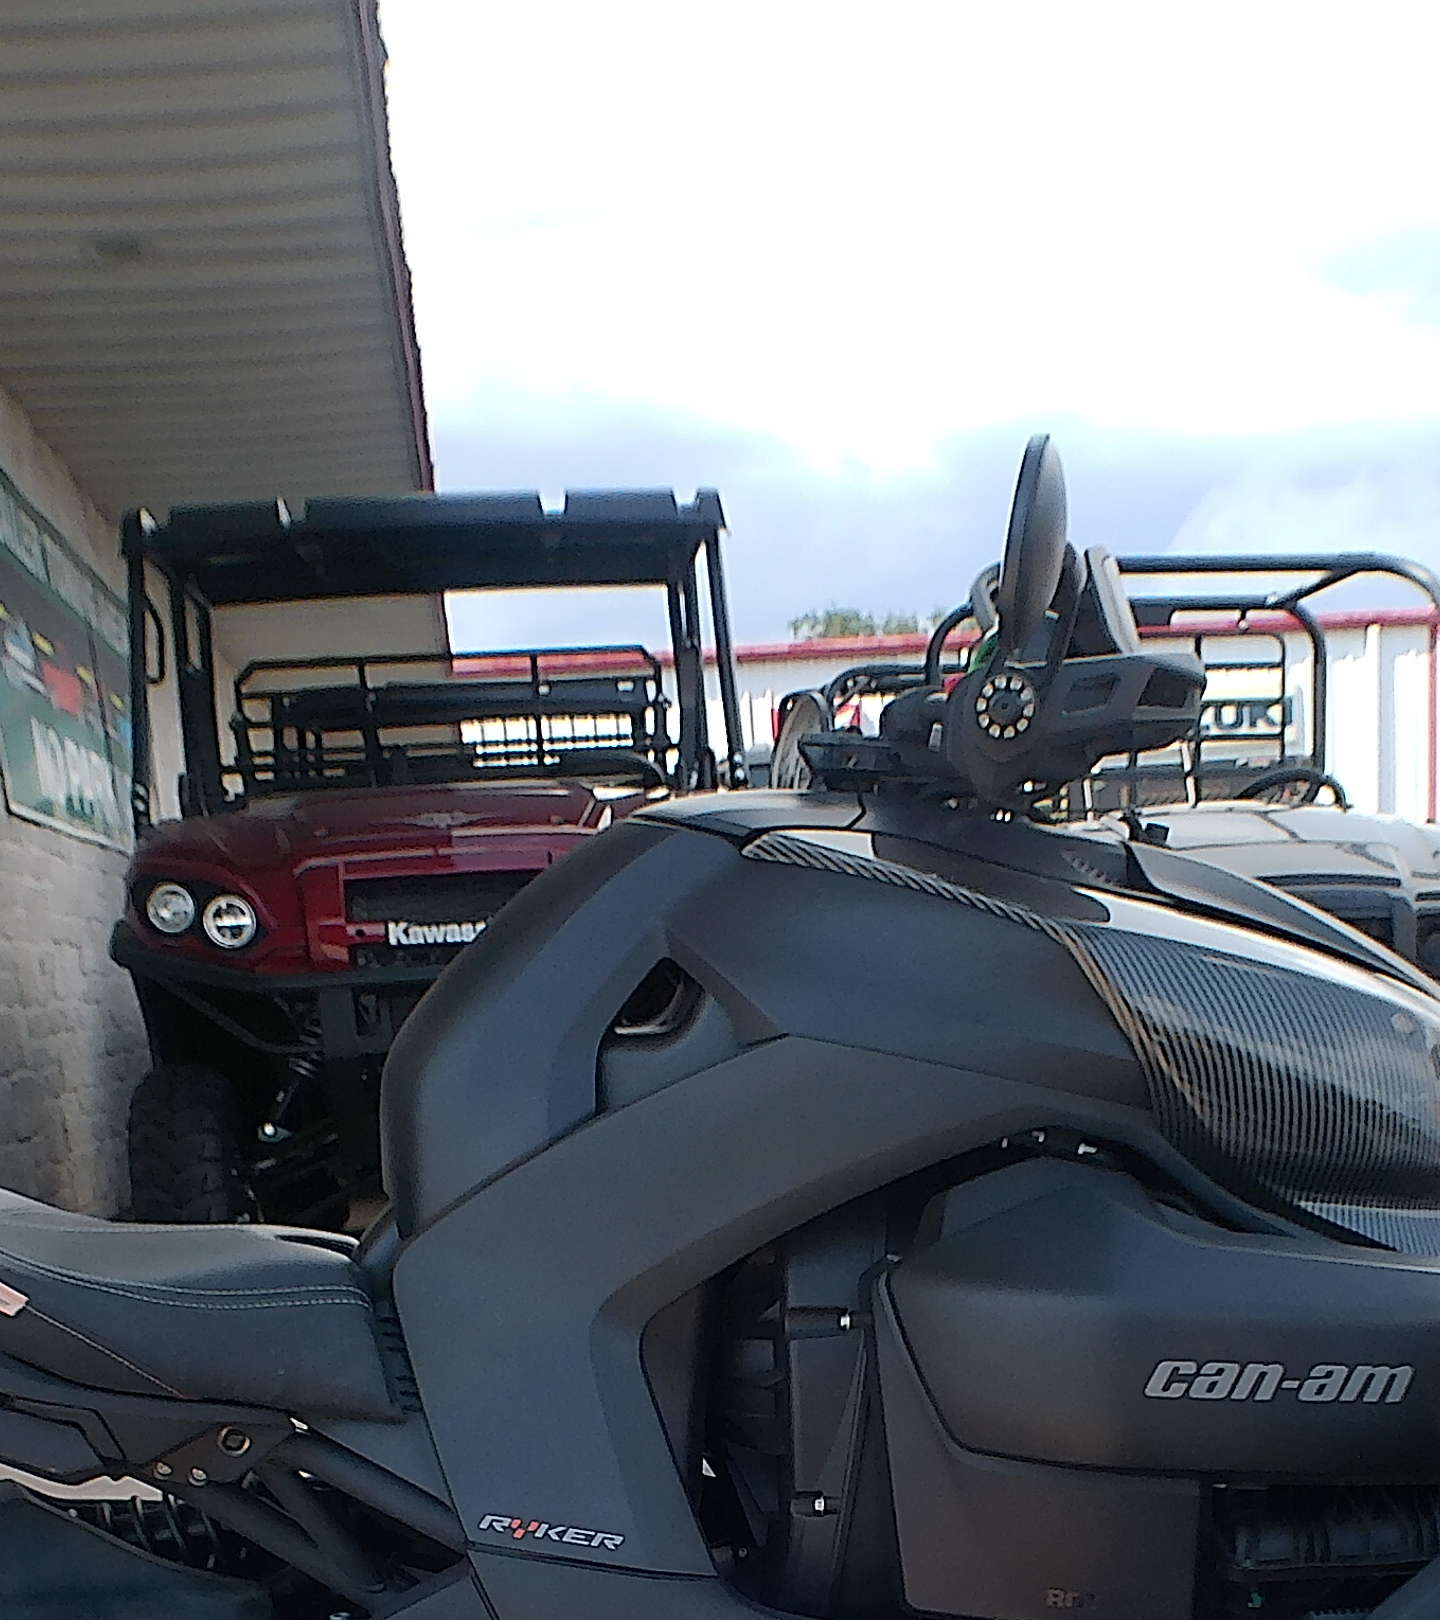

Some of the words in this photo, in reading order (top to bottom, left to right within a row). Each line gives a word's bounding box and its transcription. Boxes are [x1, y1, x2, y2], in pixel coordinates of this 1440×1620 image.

[1196, 697, 1294, 732] UKI
[1144, 1360, 1416, 1403] can-am
[478, 1514, 625, 1551] RYKER
